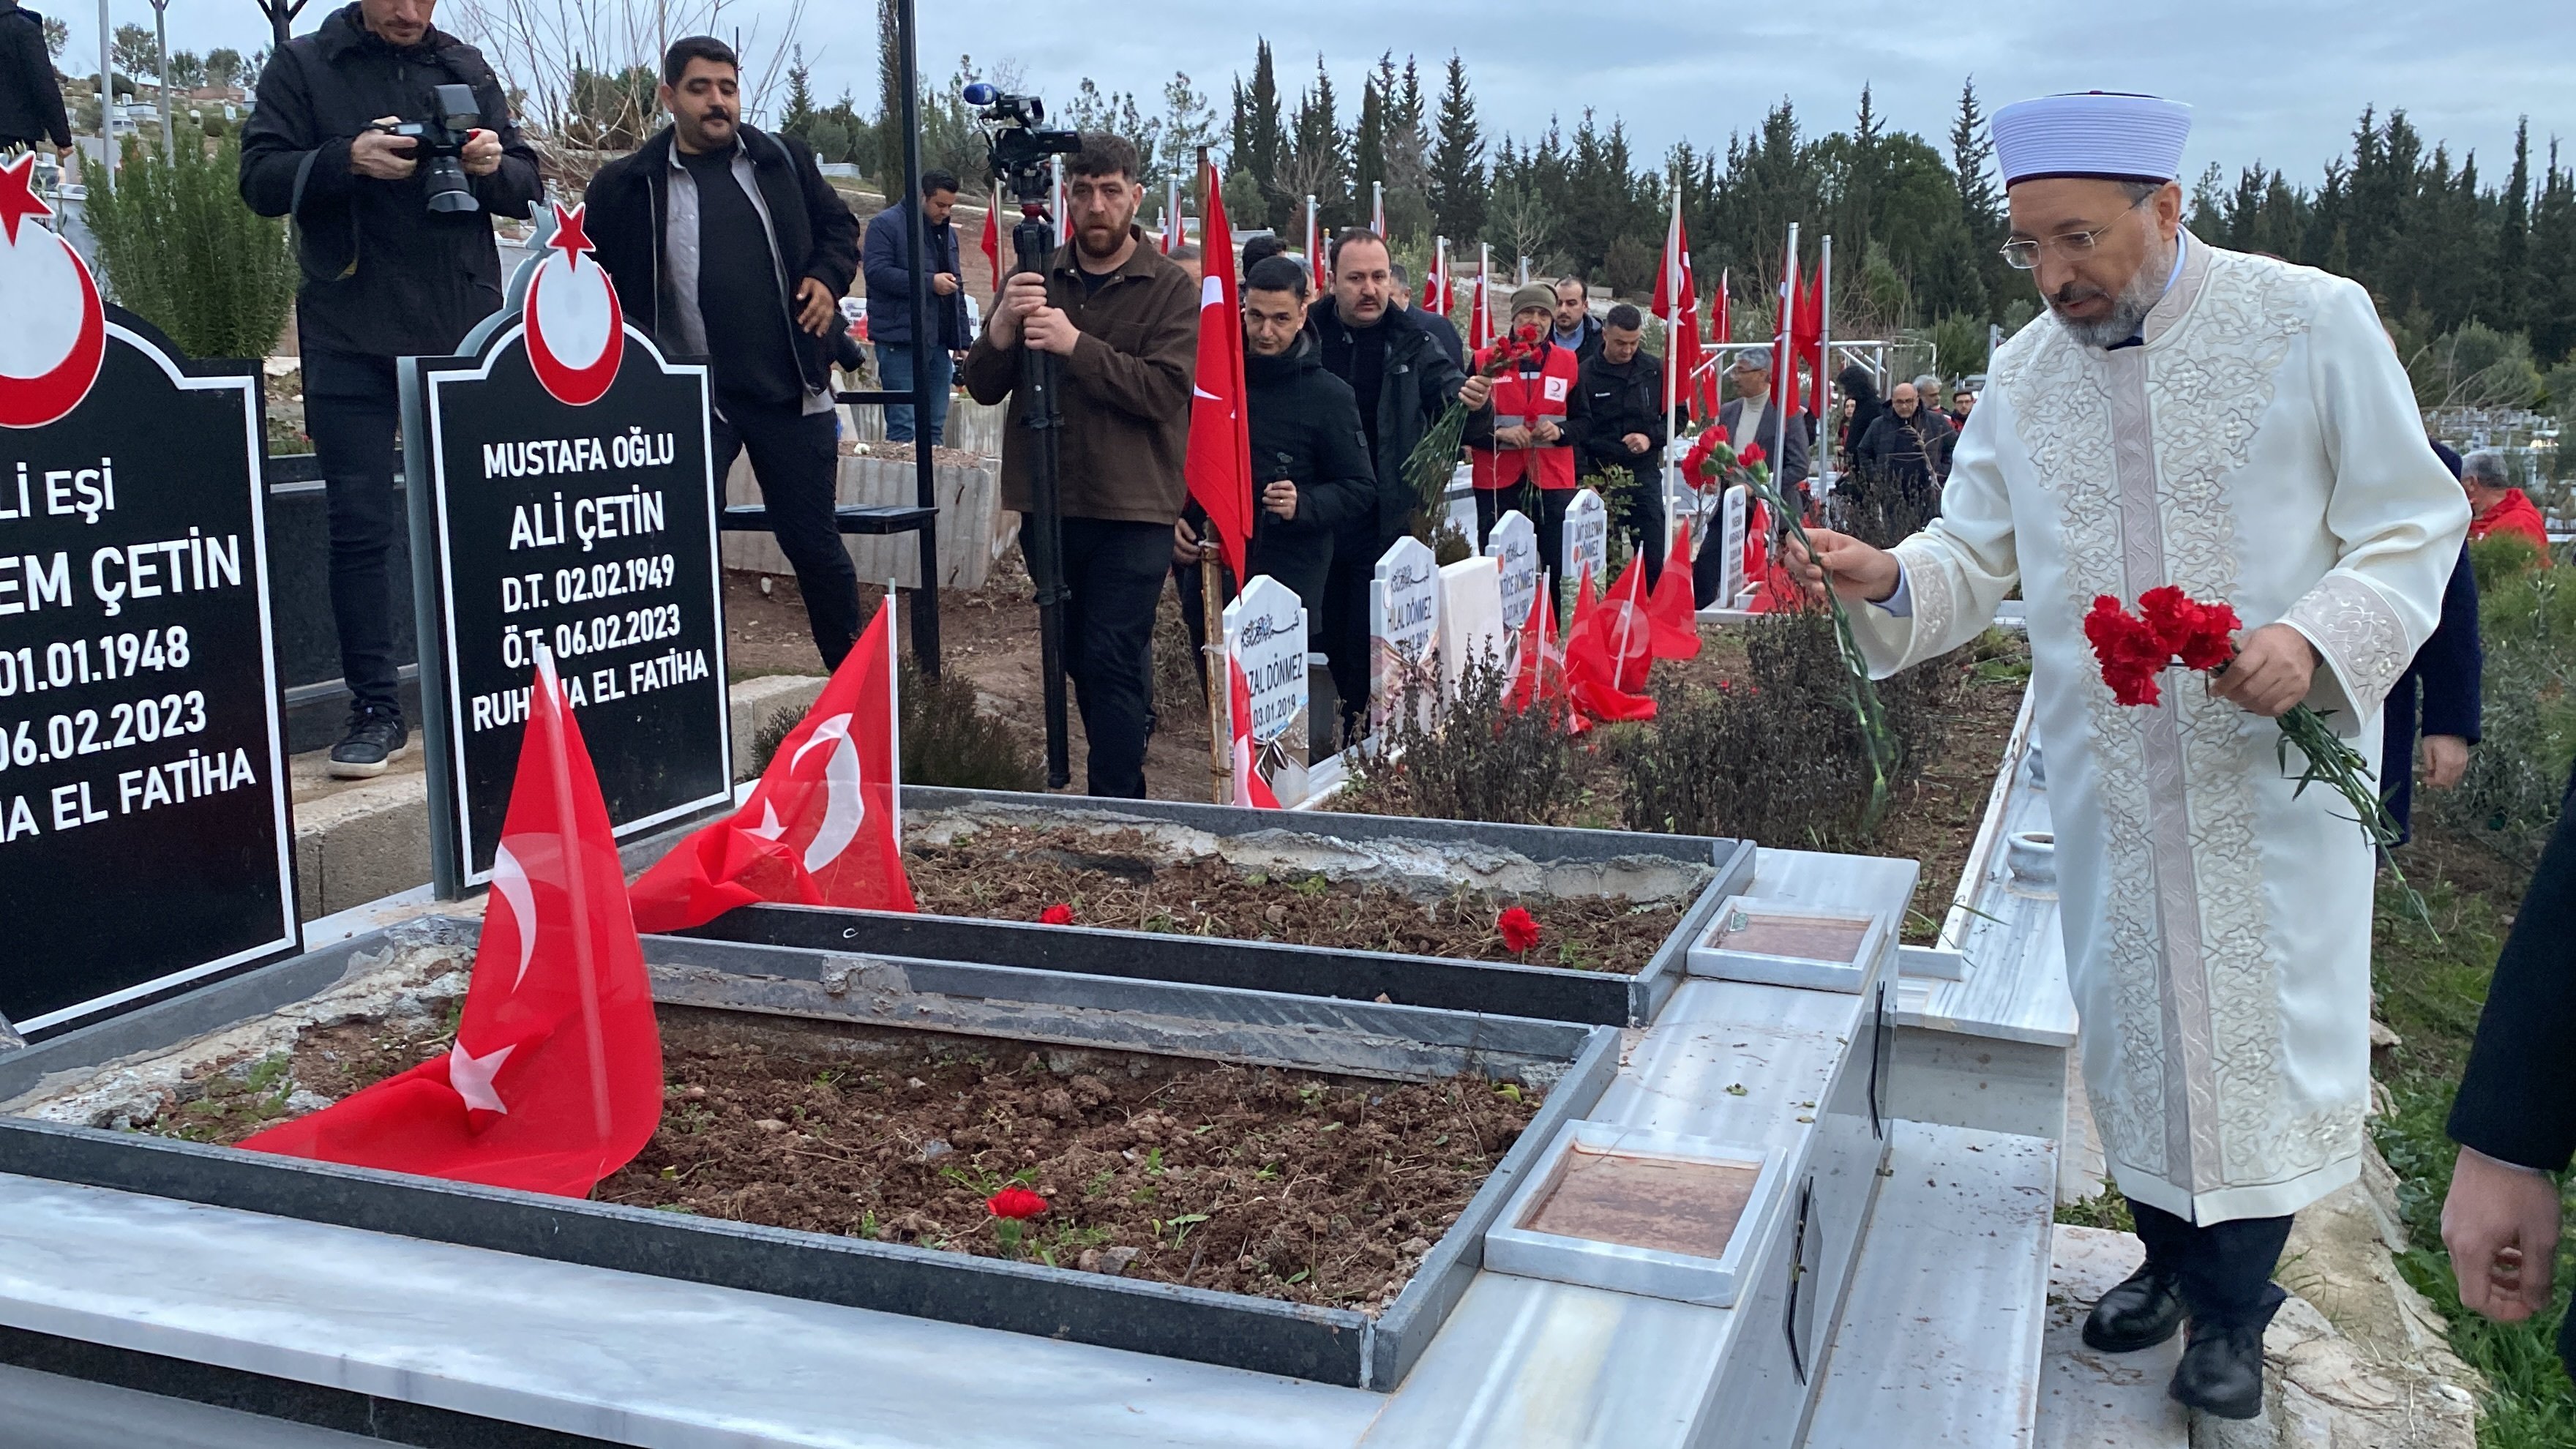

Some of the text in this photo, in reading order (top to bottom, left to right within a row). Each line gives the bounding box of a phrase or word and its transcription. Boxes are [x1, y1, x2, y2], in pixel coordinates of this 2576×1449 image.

[483, 425, 675, 479] MUSTAFA OĞLU
[45, 457, 115, 525] EŞİ
[509, 484, 664, 553] ALİ ÇETİN
[91, 526, 241, 617] ÇETİN
[501, 553, 675, 614] D.T. 02.02.1949
[555, 604, 681, 659] 06.02.2023
[1406, 596, 1432, 627] DÖNMEZ
[0, 625, 190, 697] 01.01.1948
[472, 648, 710, 733] RUHA EL FATİHA
[1266, 652, 1303, 692] DÖNMEZ
[50, 781, 109, 832] EL
[118, 746, 257, 815] FATİHA
